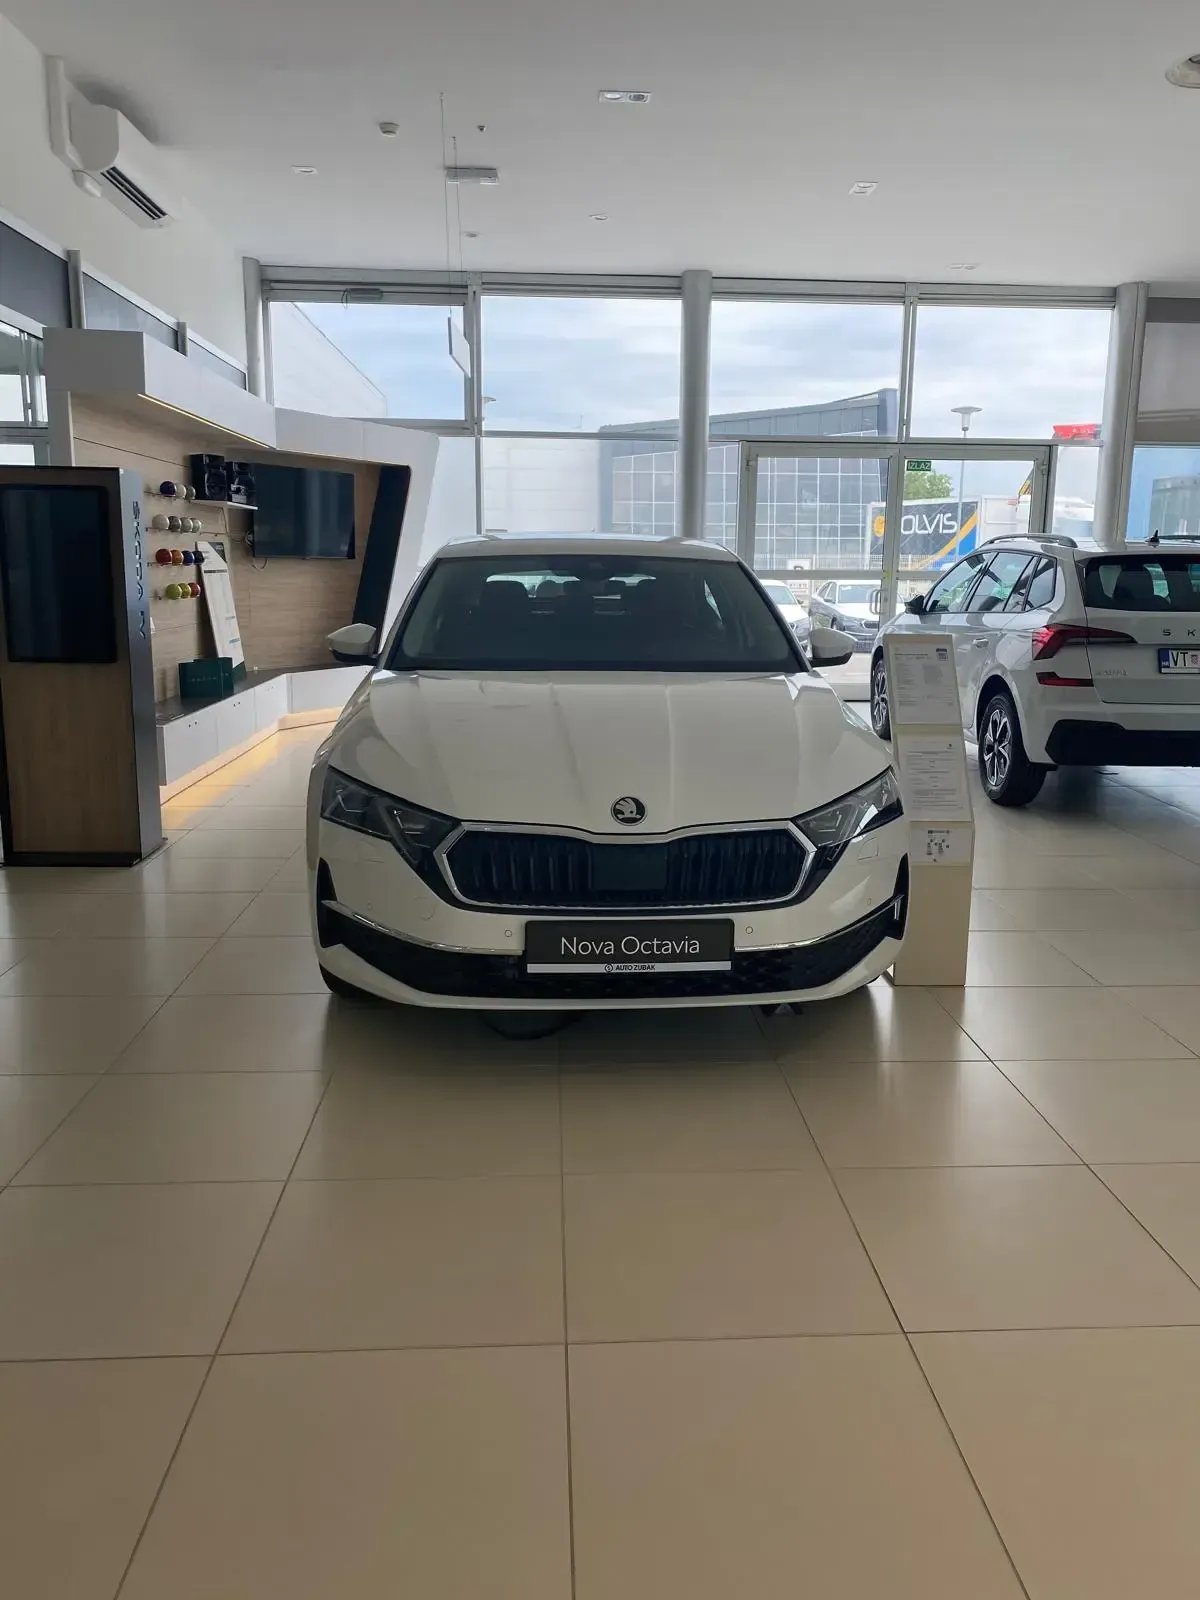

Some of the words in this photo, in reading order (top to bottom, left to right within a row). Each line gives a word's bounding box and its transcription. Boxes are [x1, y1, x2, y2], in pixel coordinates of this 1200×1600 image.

[907, 461, 931, 470] IZLAZ
[1171, 651, 1189, 667] VT
[561, 936, 615, 955] Nova
[621, 935, 700, 955] Octavia
